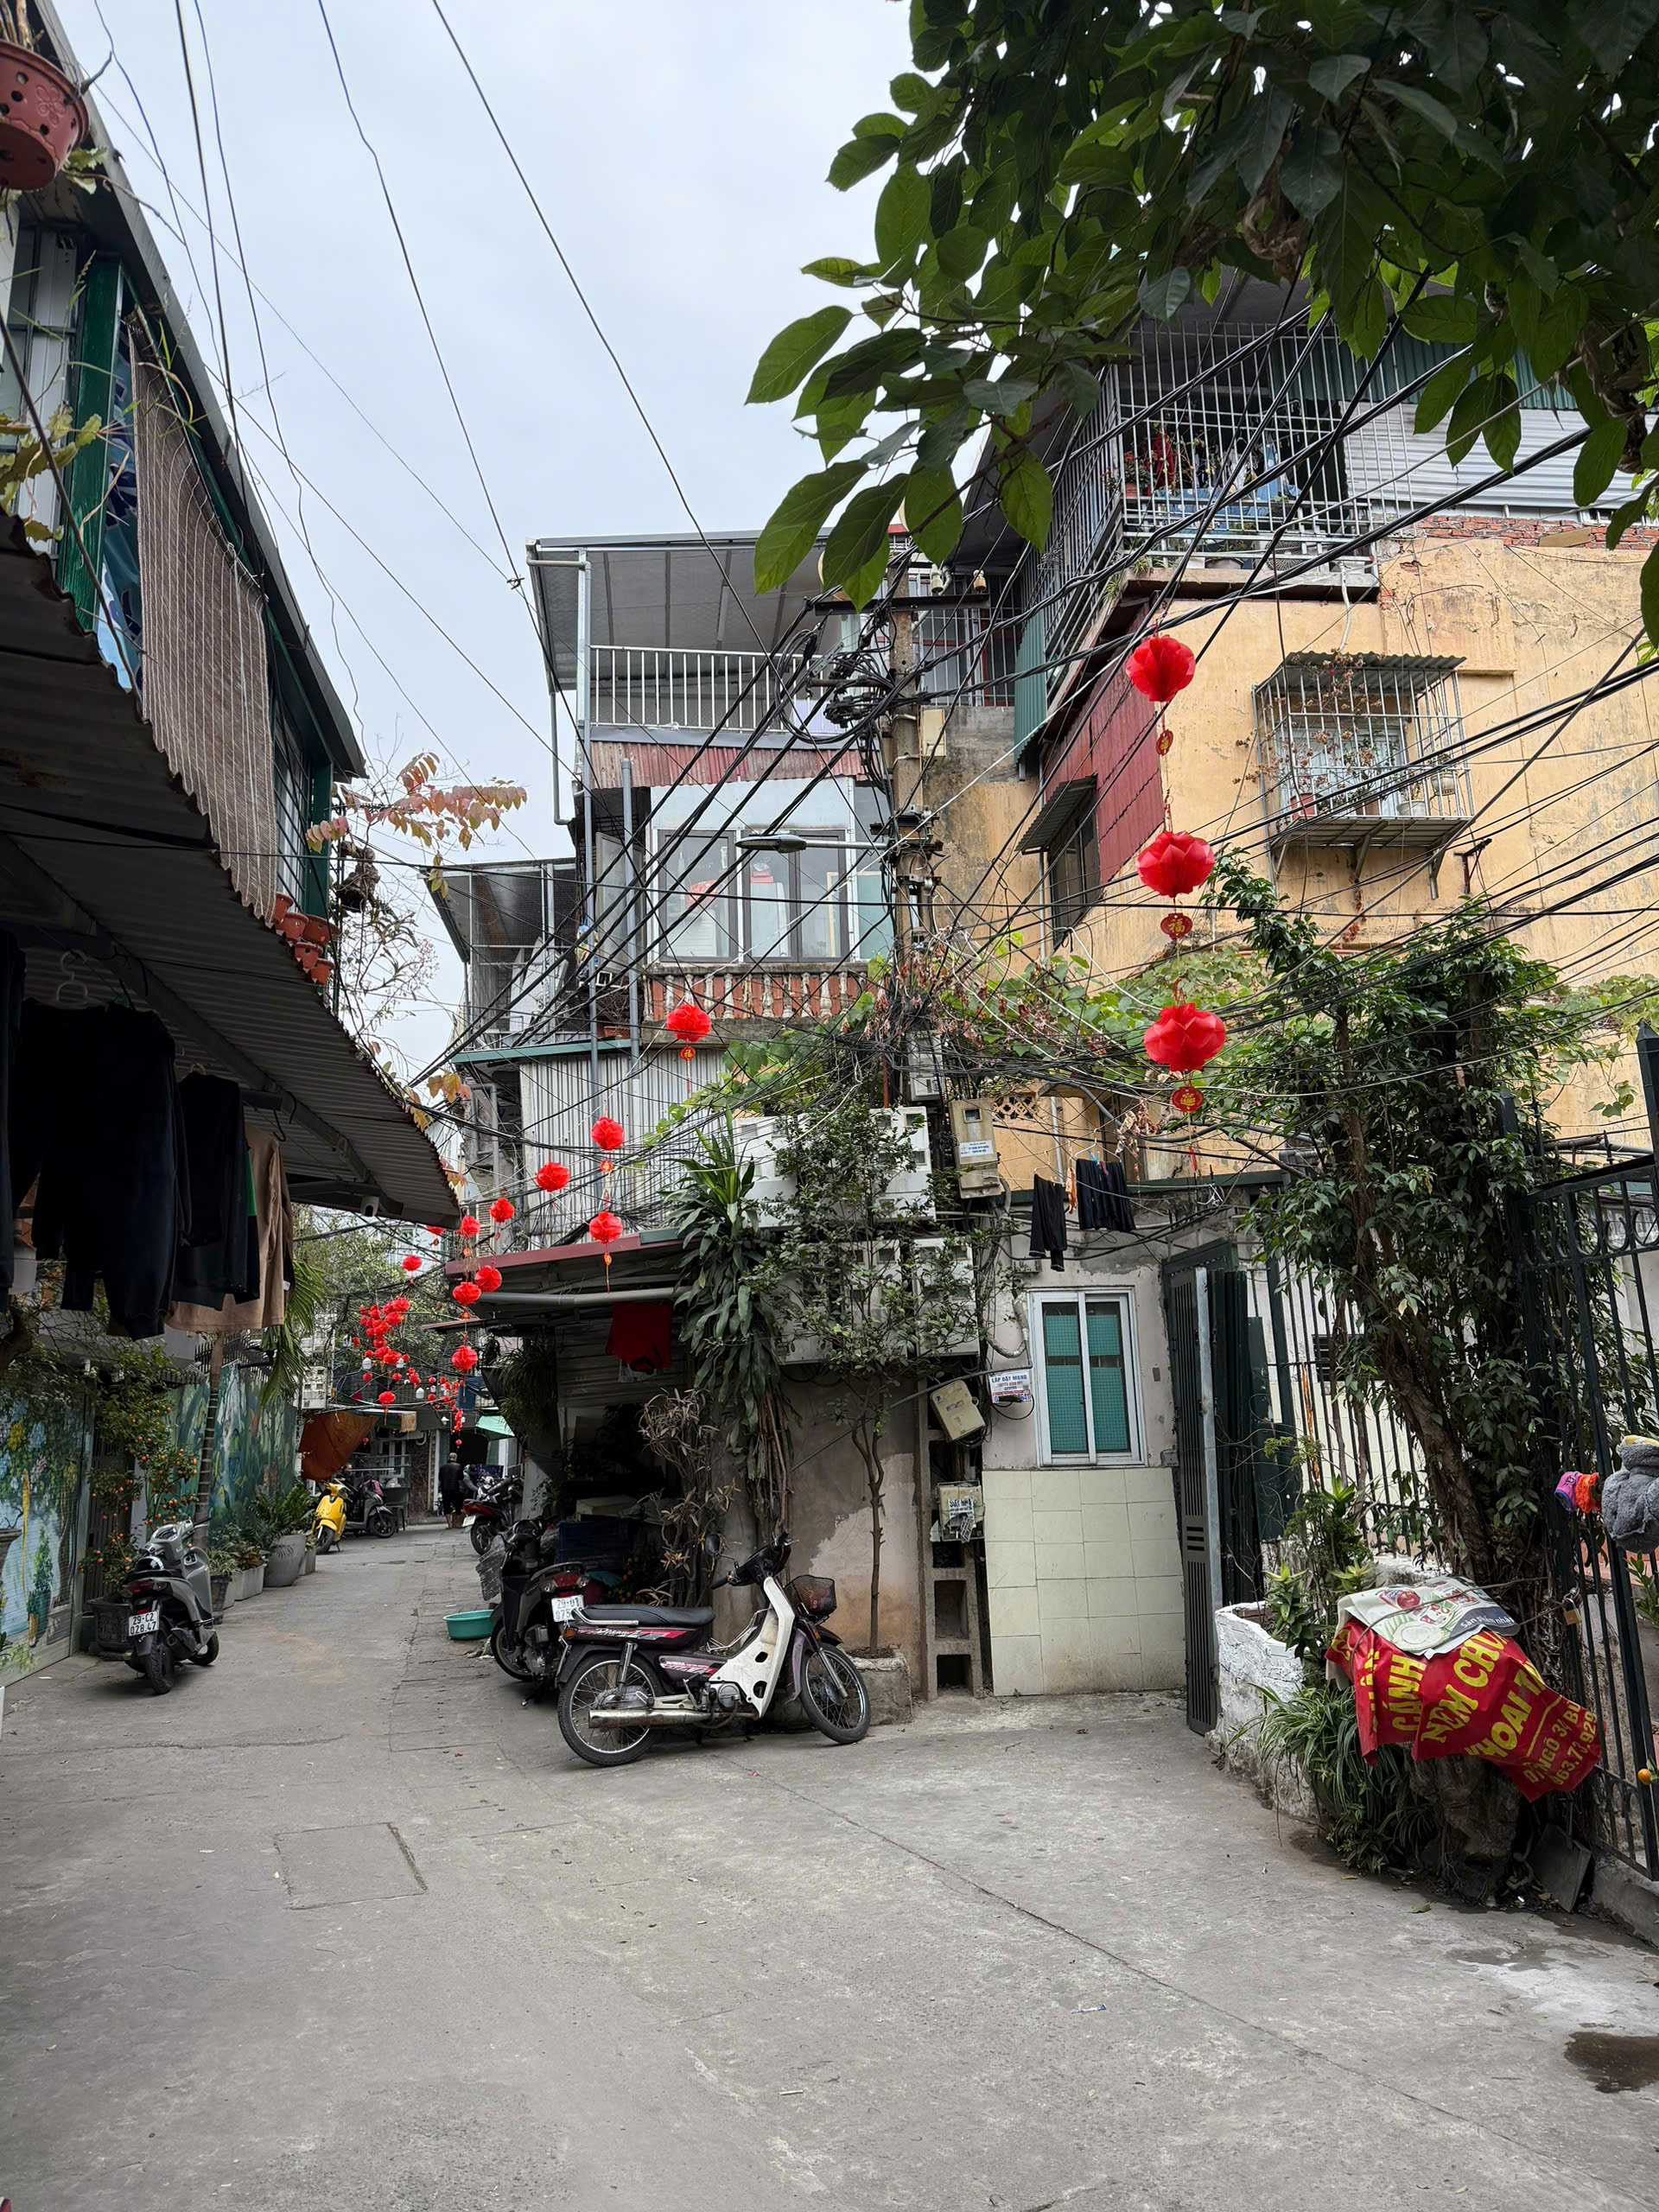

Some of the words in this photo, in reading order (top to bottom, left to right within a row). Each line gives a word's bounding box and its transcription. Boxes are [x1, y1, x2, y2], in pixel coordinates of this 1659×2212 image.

[132, 1613, 154, 1625] 29-C2
[130, 1622, 156, 1635] 028.47
[1421, 1684, 1478, 1743] NEM
